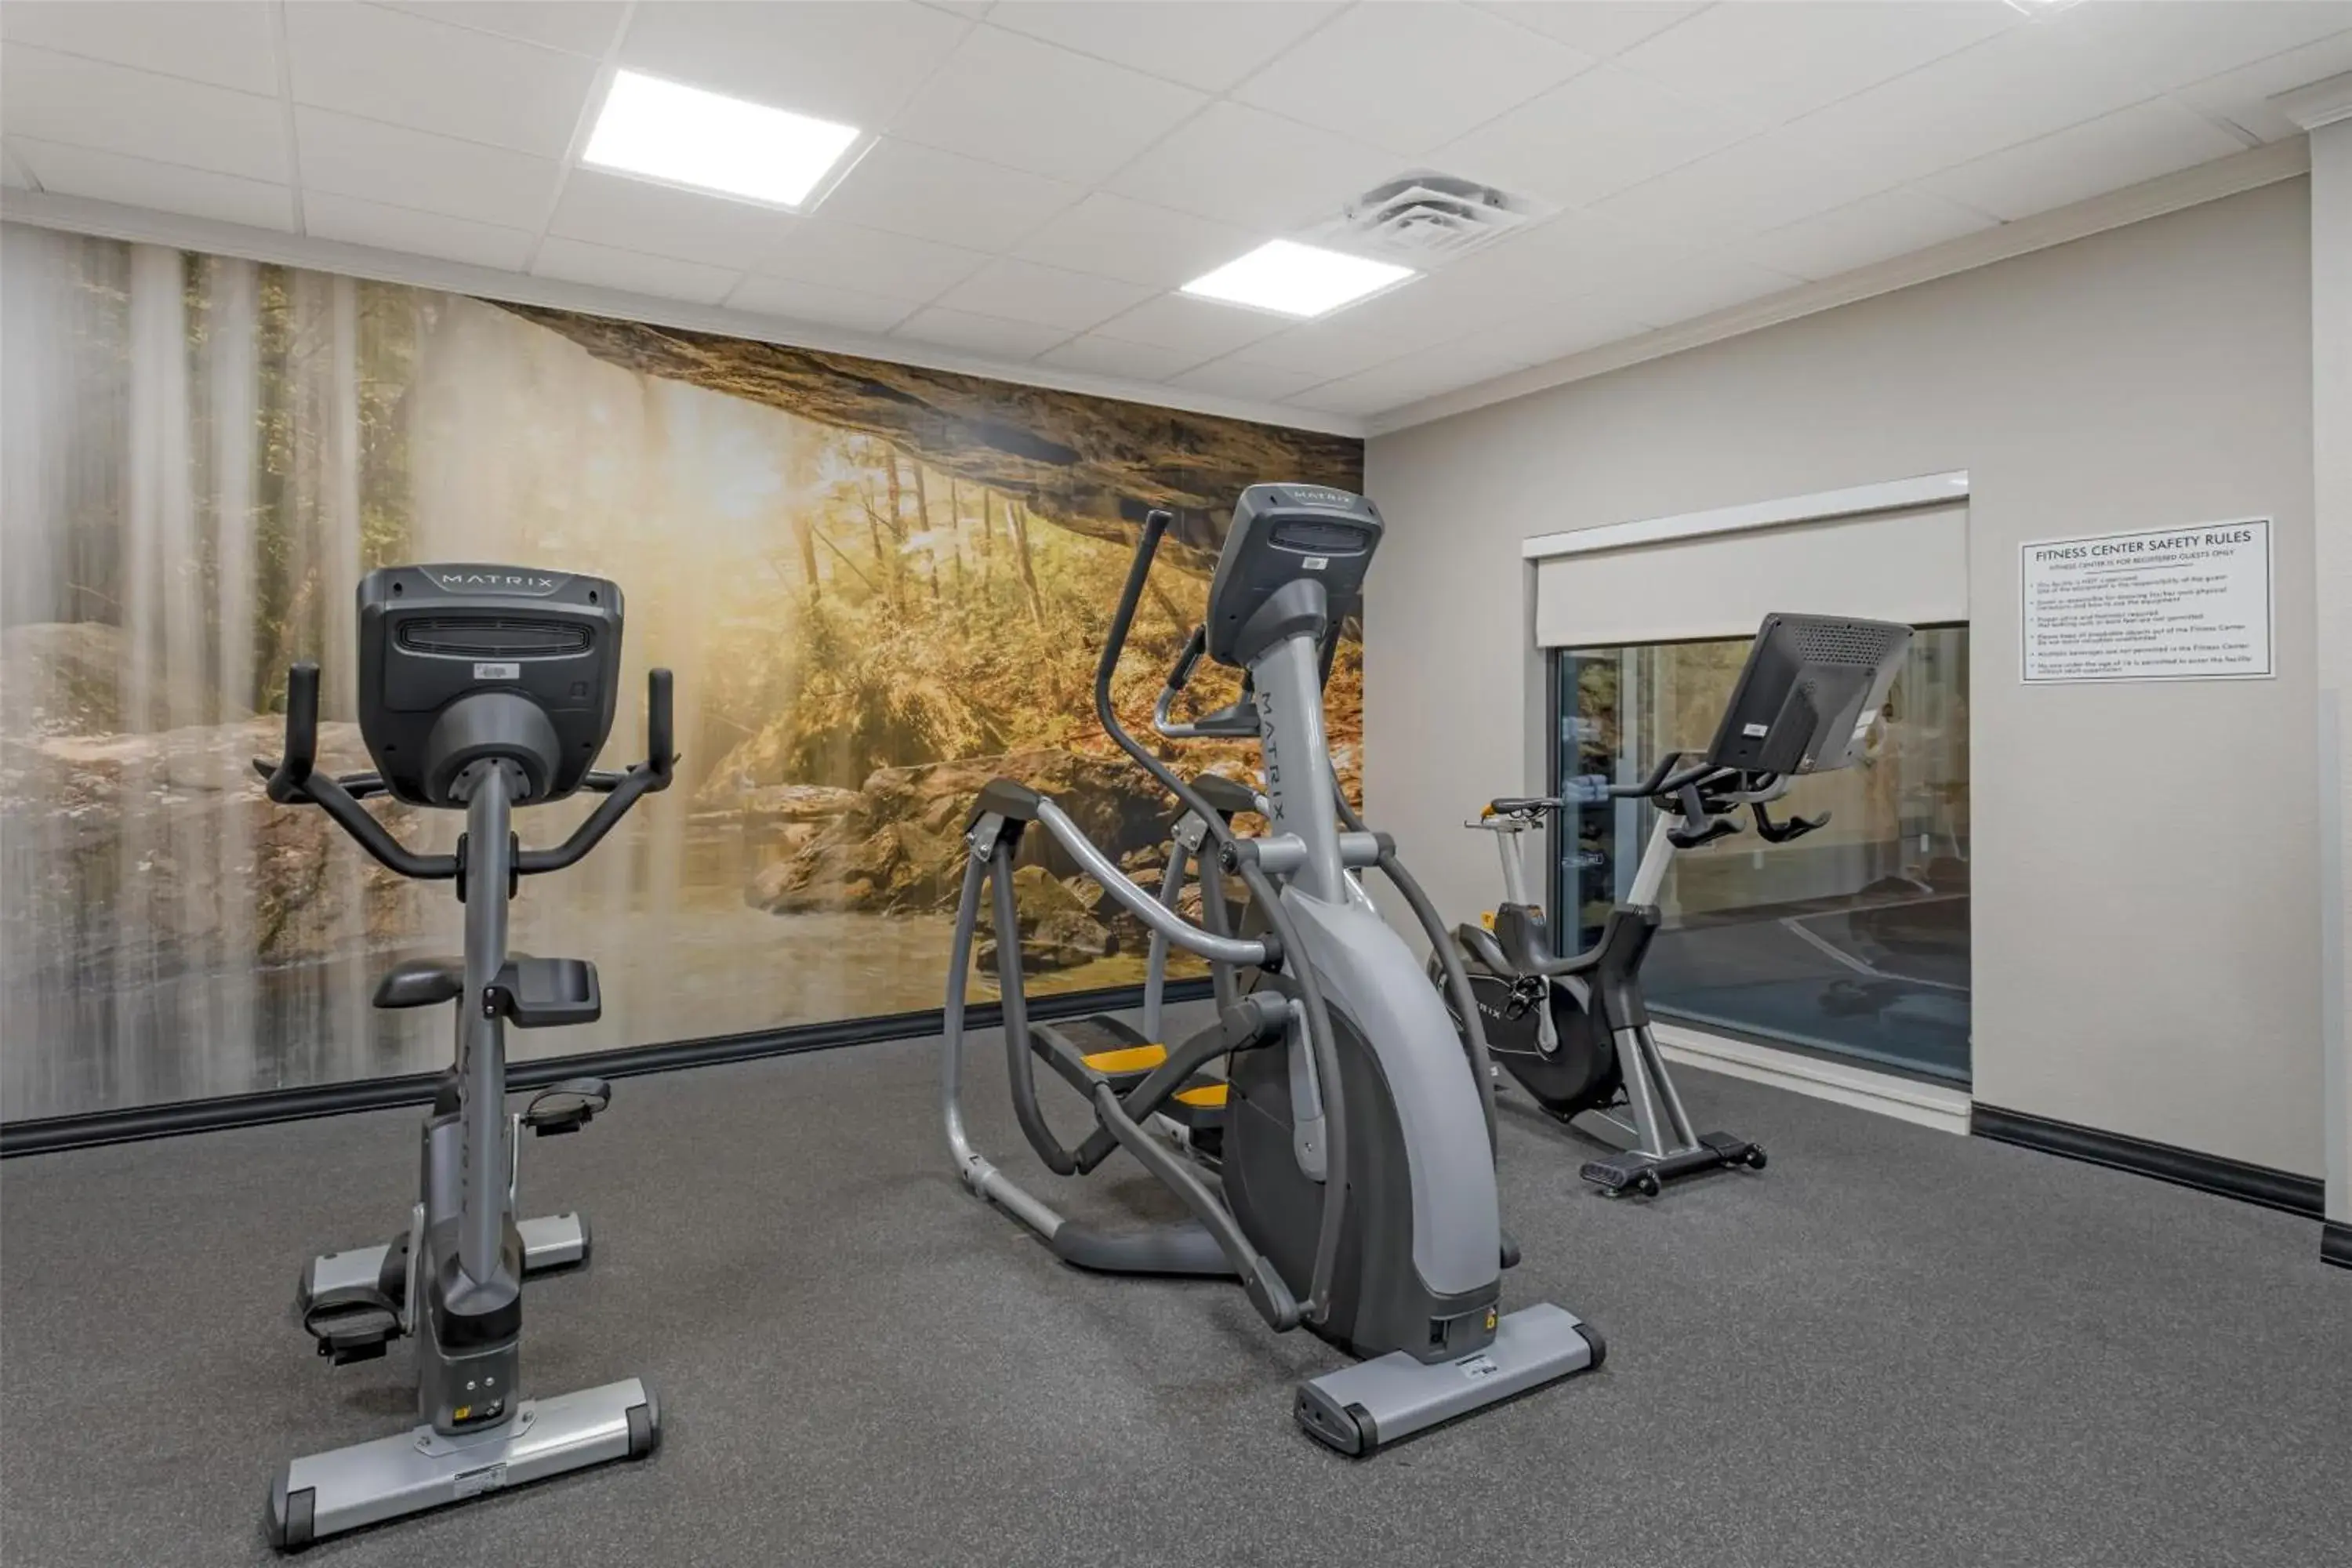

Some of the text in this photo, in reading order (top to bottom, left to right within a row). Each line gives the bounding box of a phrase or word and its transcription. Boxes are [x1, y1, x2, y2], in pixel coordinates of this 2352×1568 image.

[2036, 530, 2251, 561] FITNESS CENTER SAFETY RULES
[2179, 550, 2209, 561] GUESTS
[442, 575, 552, 587] MATRIX
[1261, 691, 1284, 821] MATRIX
[1480, 1003, 1501, 1020] RIX
